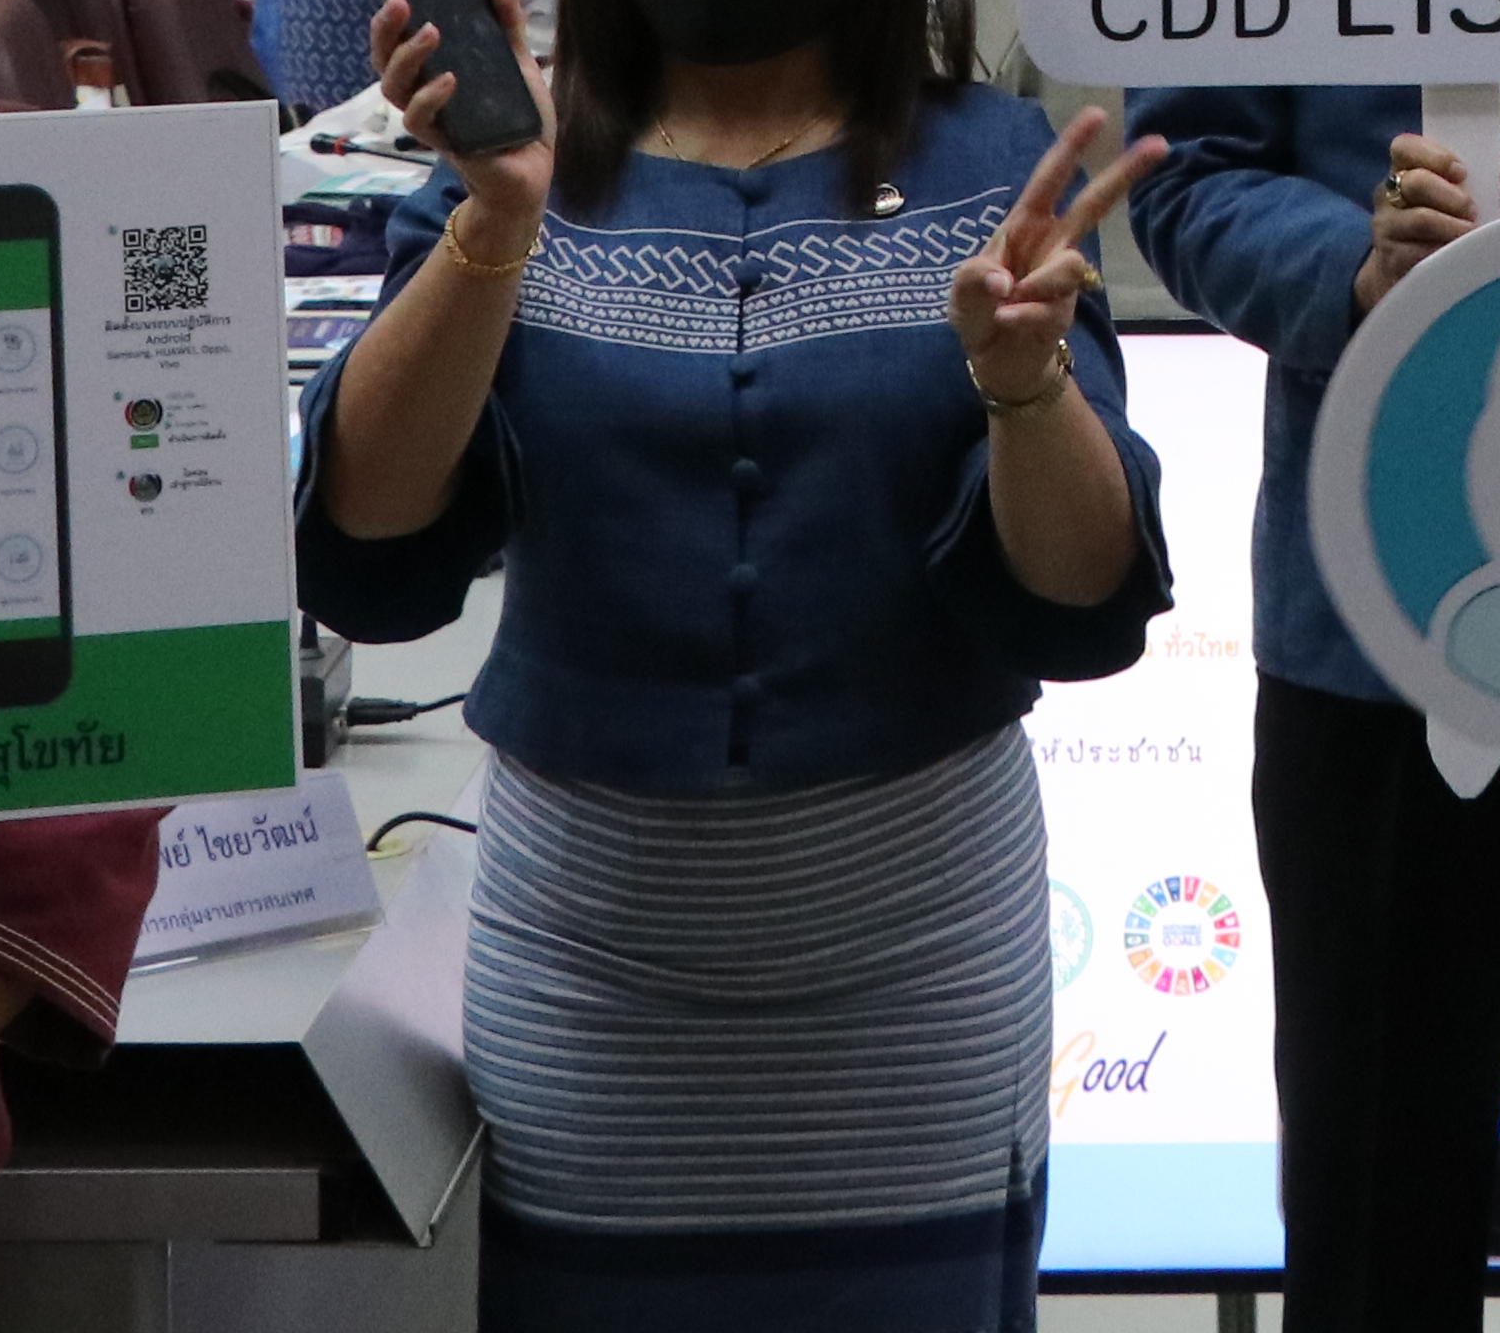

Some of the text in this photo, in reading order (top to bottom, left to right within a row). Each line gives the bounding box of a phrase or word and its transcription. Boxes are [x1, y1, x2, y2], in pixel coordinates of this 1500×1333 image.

[145, 333, 191, 346] Android
[1165, 626, 1239, 658] ทั่วไทย
[1030, 736, 1203, 764] ห้ประชาชน
[198, 804, 320, 862] ไชยวัฒน์
[1049, 1030, 1168, 1119] Good
